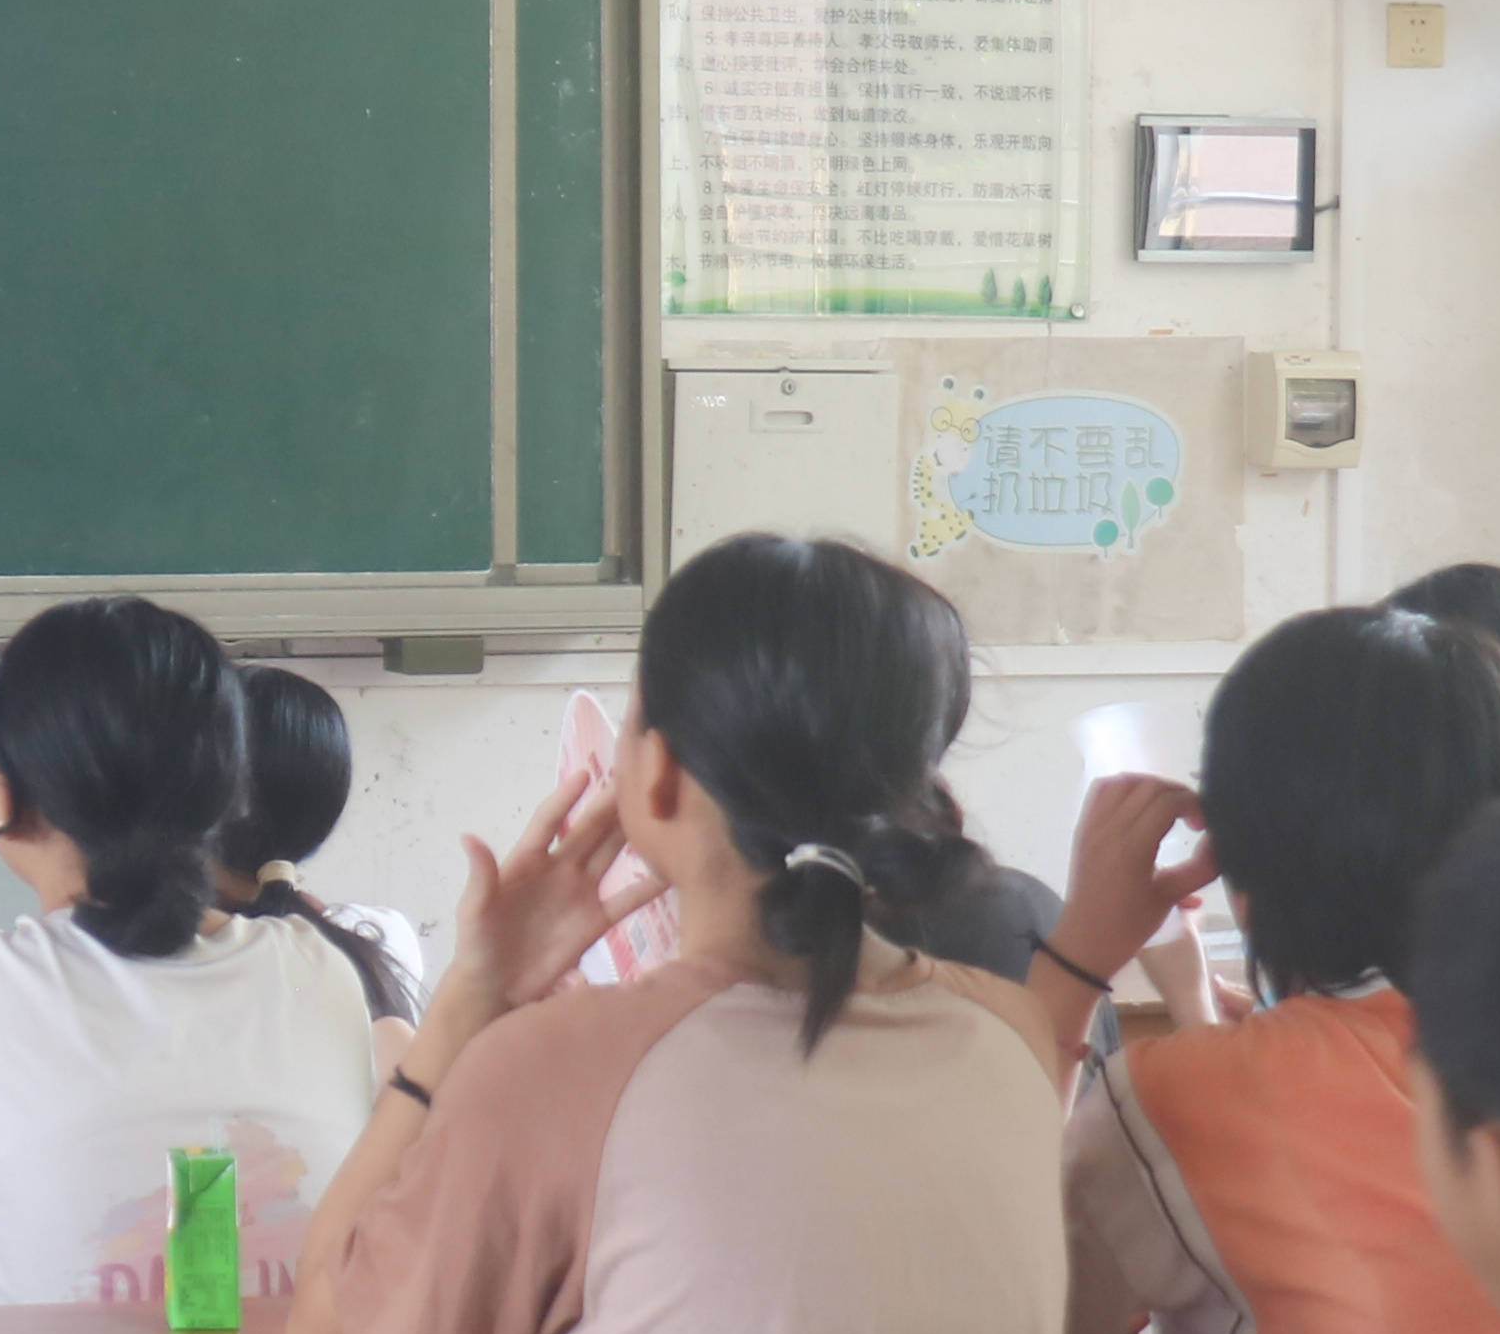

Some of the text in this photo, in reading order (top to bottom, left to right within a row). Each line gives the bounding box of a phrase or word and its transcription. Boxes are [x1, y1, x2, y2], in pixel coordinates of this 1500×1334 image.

[983, 423, 1166, 470] 请不要乱
[981, 470, 1115, 516] 扔垃圾
